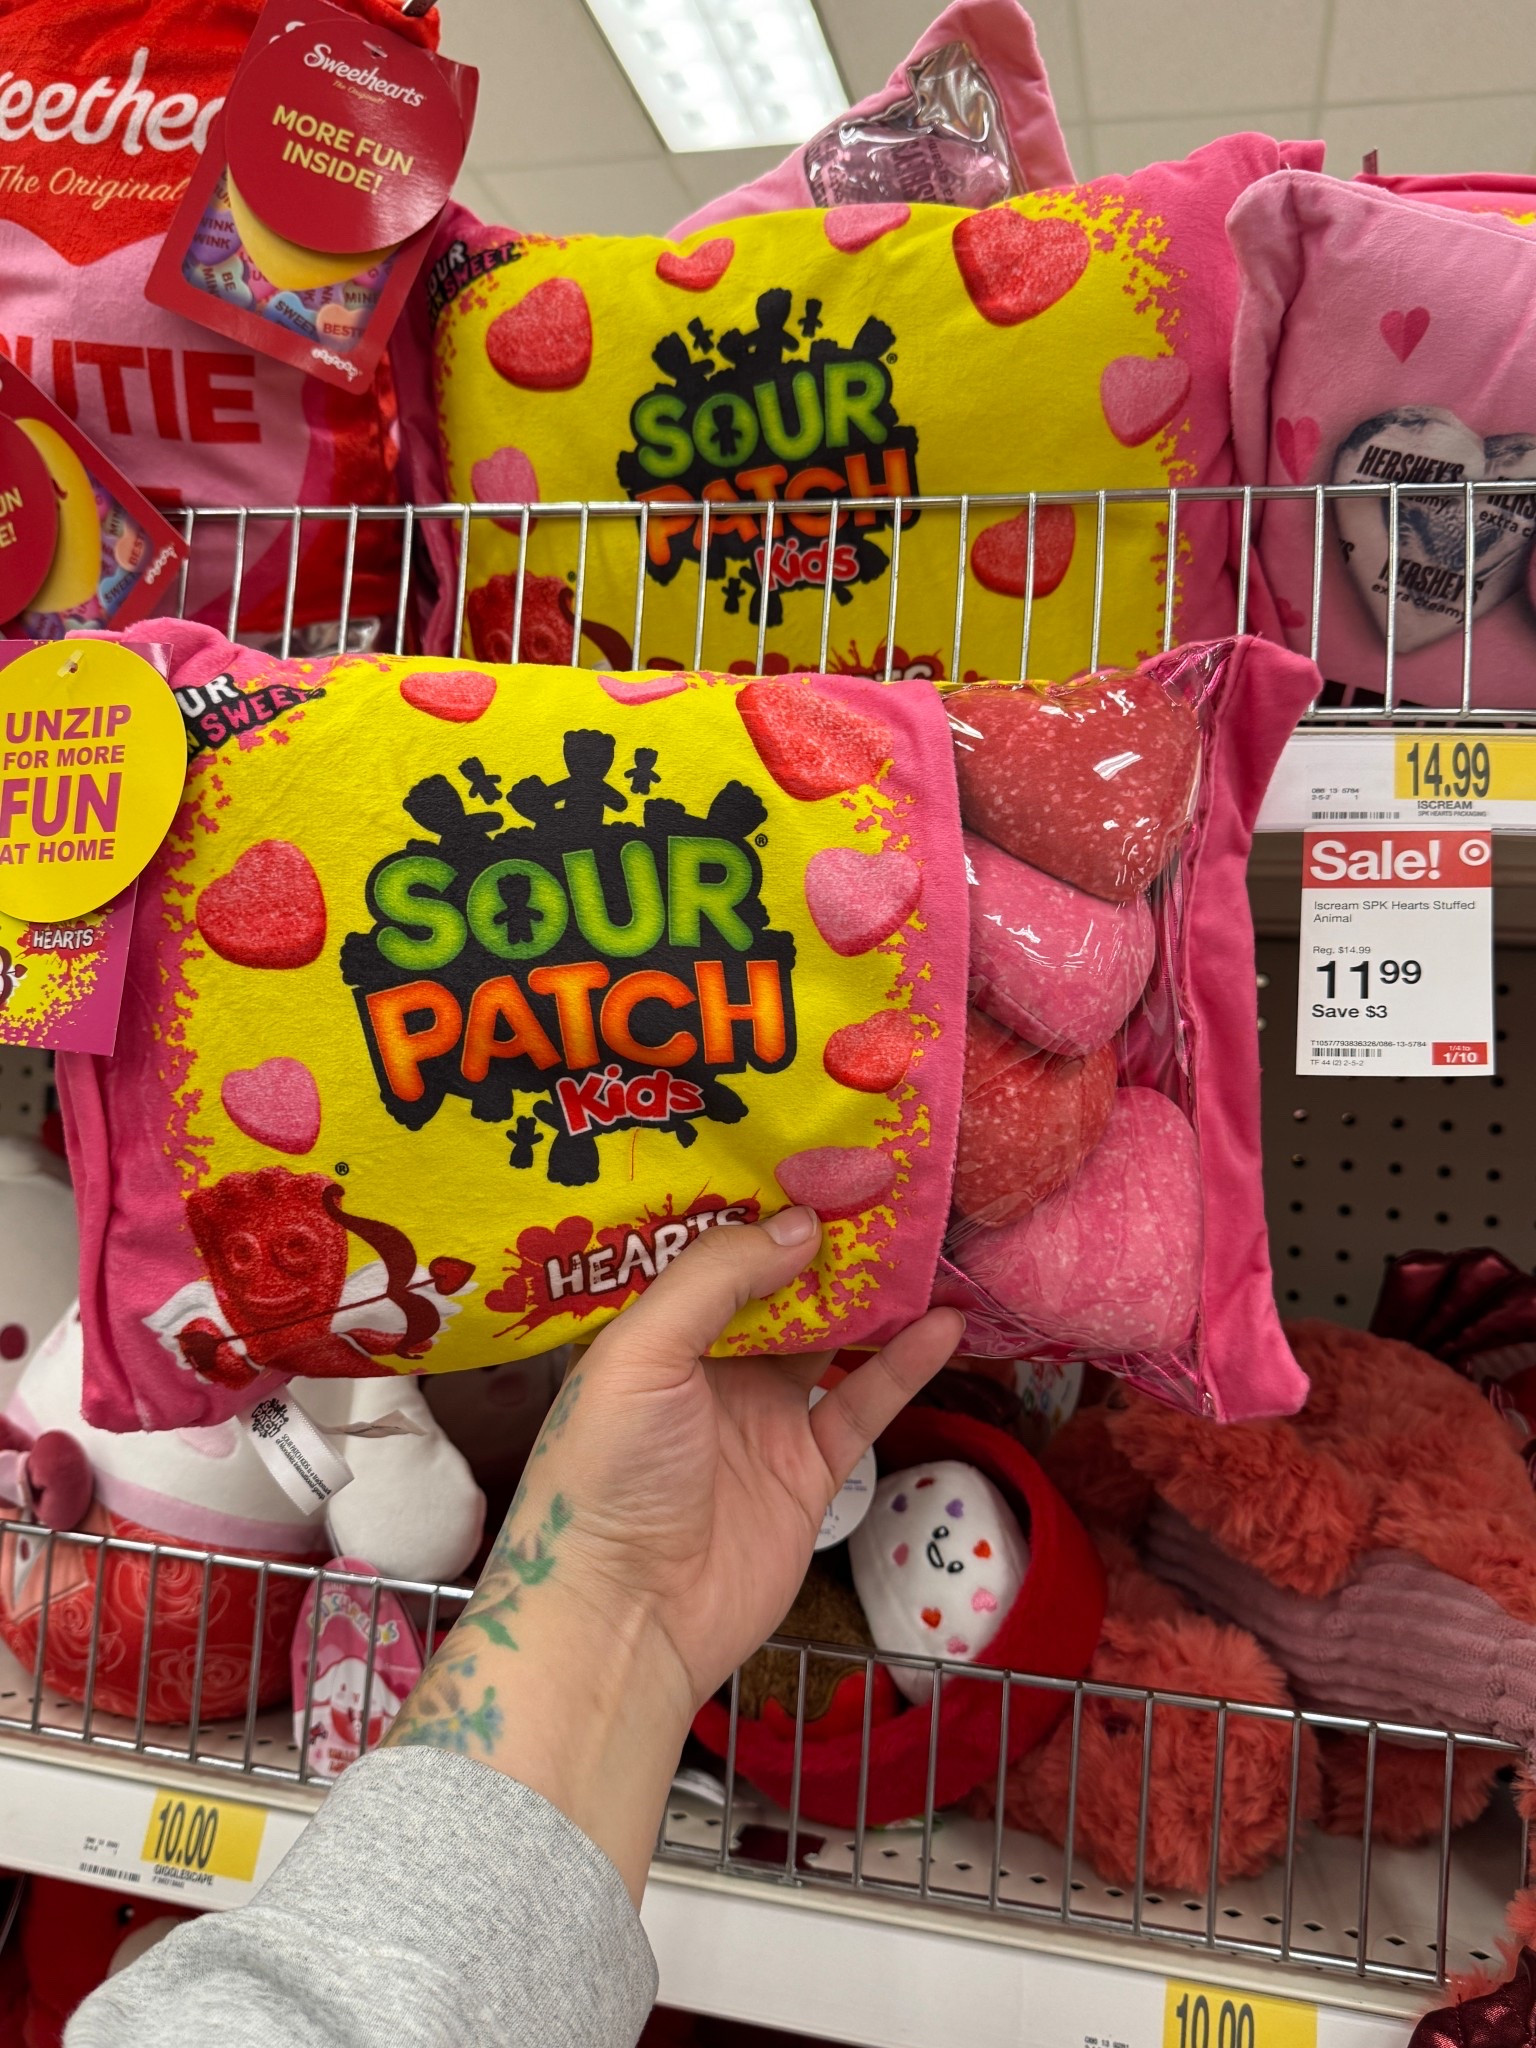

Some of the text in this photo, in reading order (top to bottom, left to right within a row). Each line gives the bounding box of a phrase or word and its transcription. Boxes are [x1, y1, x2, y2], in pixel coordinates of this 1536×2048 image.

[303, 42, 424, 107] Sweethearts
[272, 104, 415, 176] MORE FUN
[0, 165, 40, 194] The
[49, 167, 191, 211] Original
[282, 140, 384, 195] INSIDE!
[202, 267, 220, 297] MIN
[222, 271, 236, 292] BE
[428, 242, 466, 295] OUR
[0, 333, 262, 444] UTIE
[635, 361, 888, 478] SOUR
[1356, 445, 1465, 483] HERSHEY'S
[635, 448, 913, 567] PATCH
[1479, 509, 1519, 533] extra
[754, 537, 860, 591] Kids
[1378, 559, 1485, 606] HERSHEYS
[1371, 583, 1410, 602] exra
[175, 675, 239, 718] UR
[201, 687, 309, 742] SWEET
[6, 704, 131, 744] UNZIP
[3, 744, 126, 770] FOR MORE
[1406, 742, 1490, 798] 14.99
[0, 772, 122, 838] FUN
[0, 838, 116, 865] AT HOME
[1310, 839, 1441, 881] Sale!
[373, 834, 754, 972] SOUR
[1313, 913, 1352, 924] Animal
[1314, 900, 1476, 910] Iscream SPK Hearts Stuffed
[33, 928, 94, 950] HEARTS
[1312, 945, 1372, 956] Reg. $14.99
[366, 959, 787, 1103] PATCH
[1311, 1003, 1388, 1018] Save $3
[1442, 1052, 1478, 1064] 1/10
[555, 1063, 706, 1136] Kids
[253, 1407, 278, 1437] PATCH
[262, 1401, 285, 1427] SOUR
[289, 1444, 303, 1460] PATCH
[154, 1799, 219, 1869] 10.00
[1176, 1992, 1255, 2048] 1000
